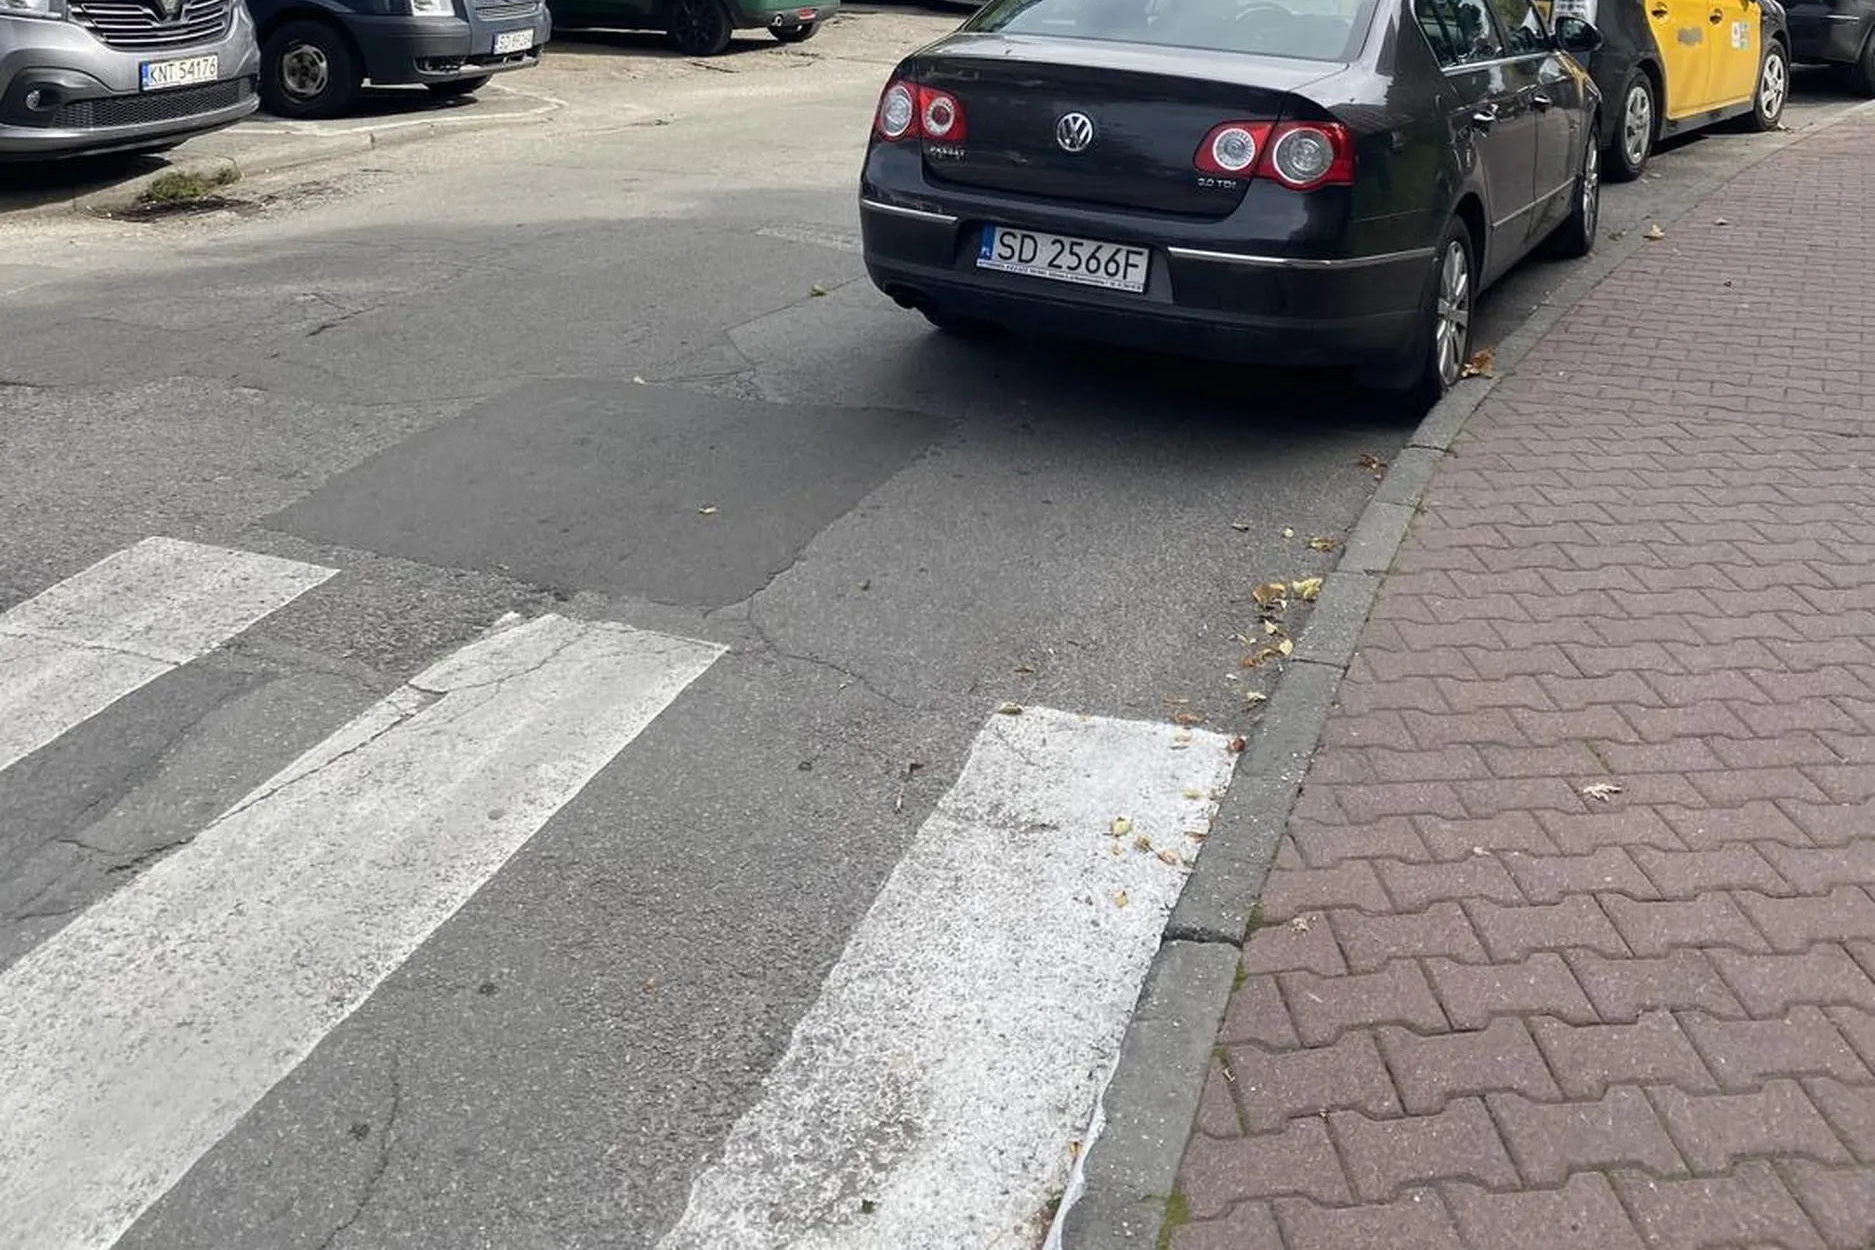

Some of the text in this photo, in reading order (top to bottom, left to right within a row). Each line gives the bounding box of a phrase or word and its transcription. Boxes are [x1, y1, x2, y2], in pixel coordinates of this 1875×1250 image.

[150, 57, 216, 83] KNT 54176
[997, 231, 1039, 264] SD
[1047, 238, 1144, 281] 2566F
